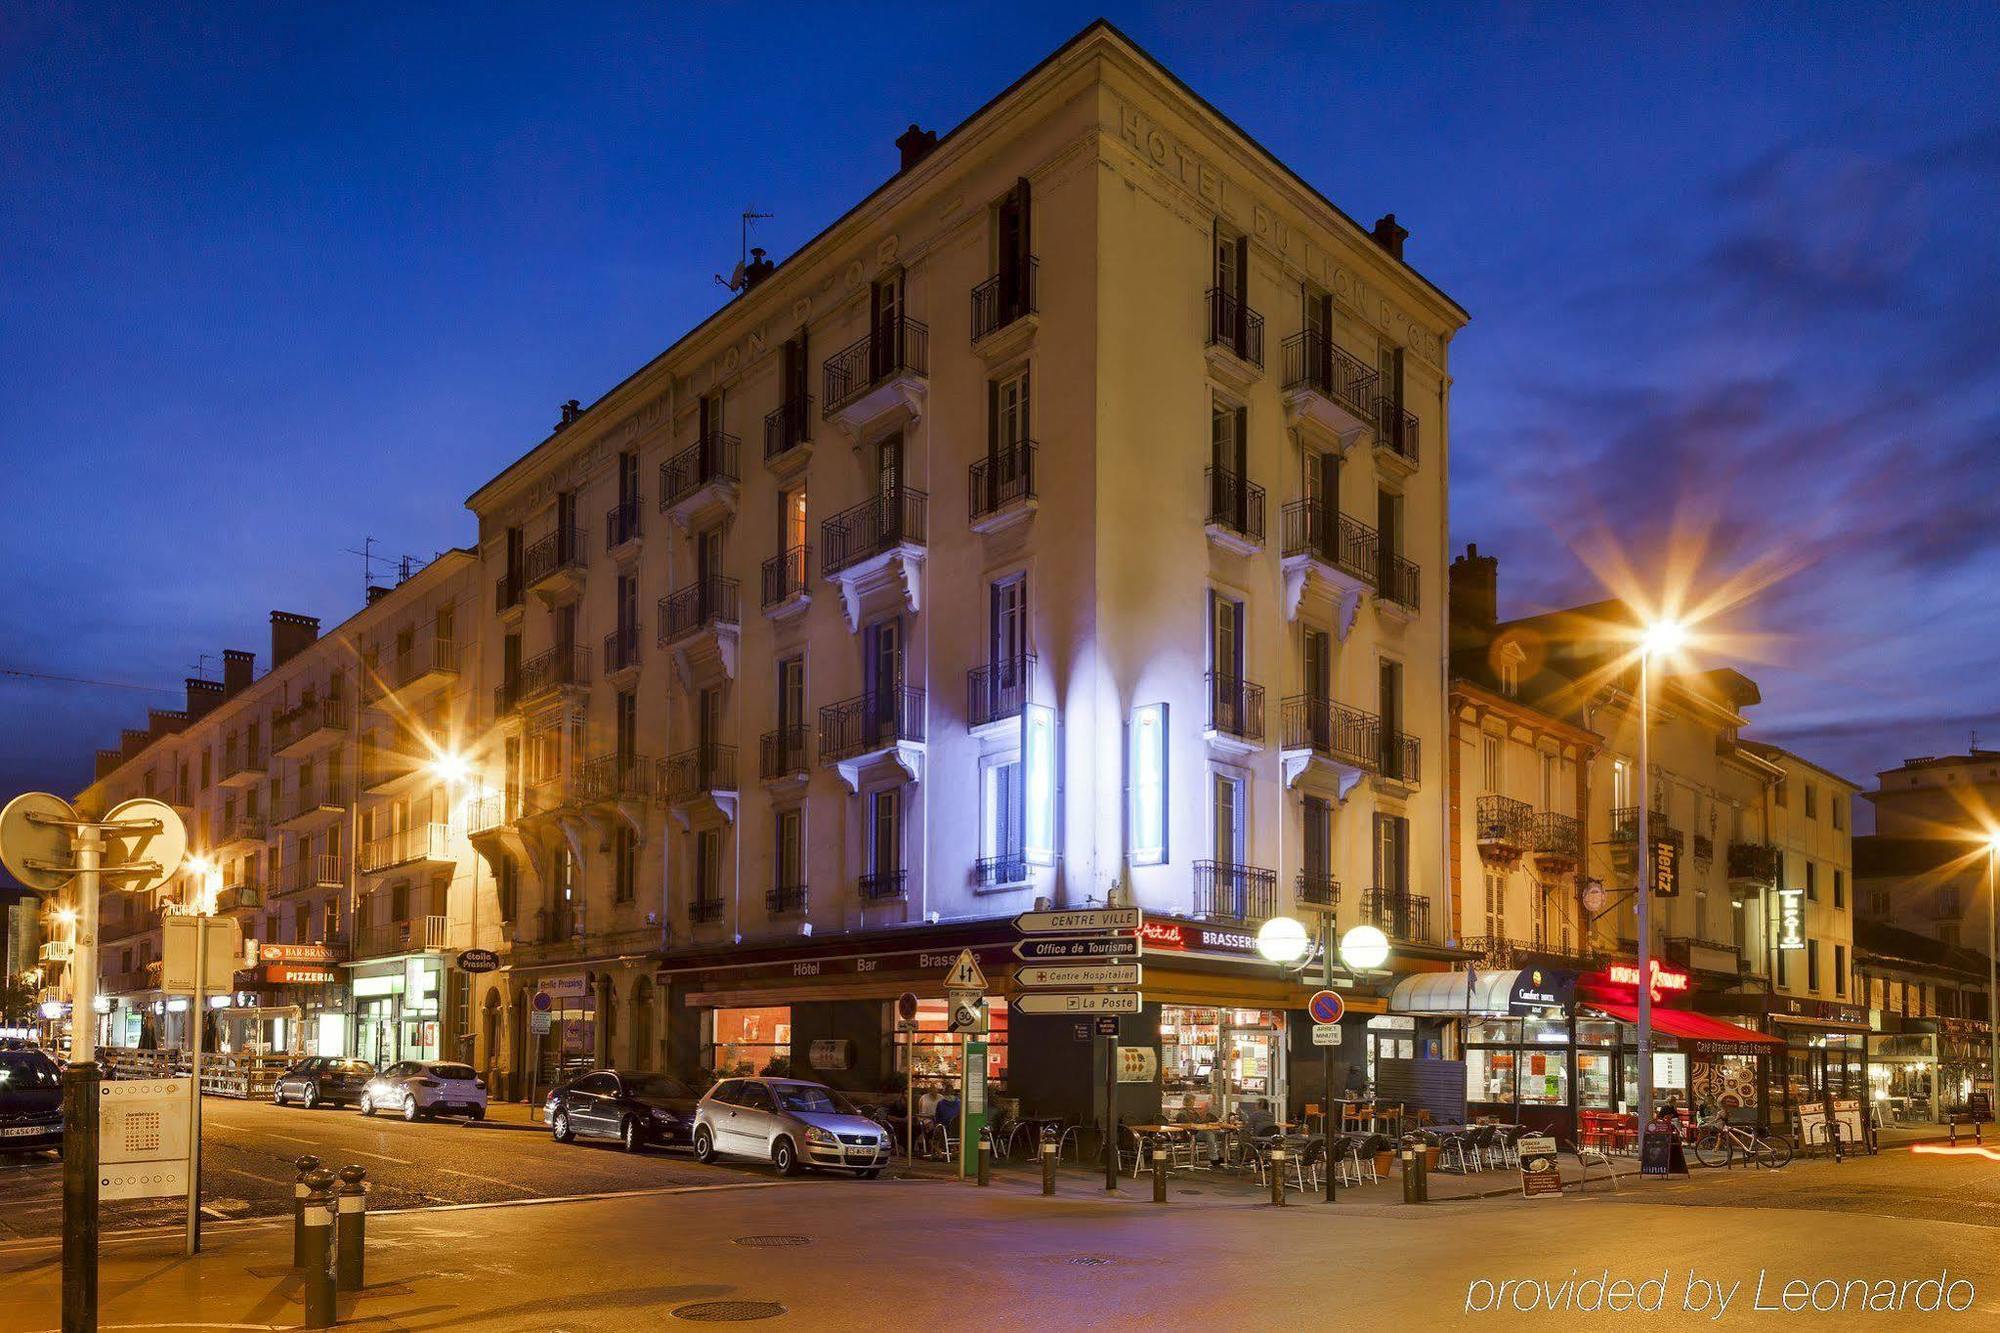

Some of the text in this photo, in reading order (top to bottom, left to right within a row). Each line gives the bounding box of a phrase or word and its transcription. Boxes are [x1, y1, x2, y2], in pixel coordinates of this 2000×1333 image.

[1121, 105, 1236, 221] HOTEL
[1254, 206, 1288, 256] DU
[1305, 244, 1369, 315] LION
[1657, 842, 1674, 892] Hertz
[1051, 912, 1133, 927] CENTRE VILLE
[1202, 931, 1260, 949] BRASSERI
[1036, 941, 1133, 954] Office de Tourisme
[857, 958, 877, 972] Bar
[919, 953, 982, 968] Brasse
[793, 961, 821, 976] Hôtel
[1049, 970, 1134, 981] Centre Hospitalier
[286, 971, 335, 982] PIZZERIA
[1083, 997, 1133, 1008] La Poste
[959, 1011, 972, 1019] 30
